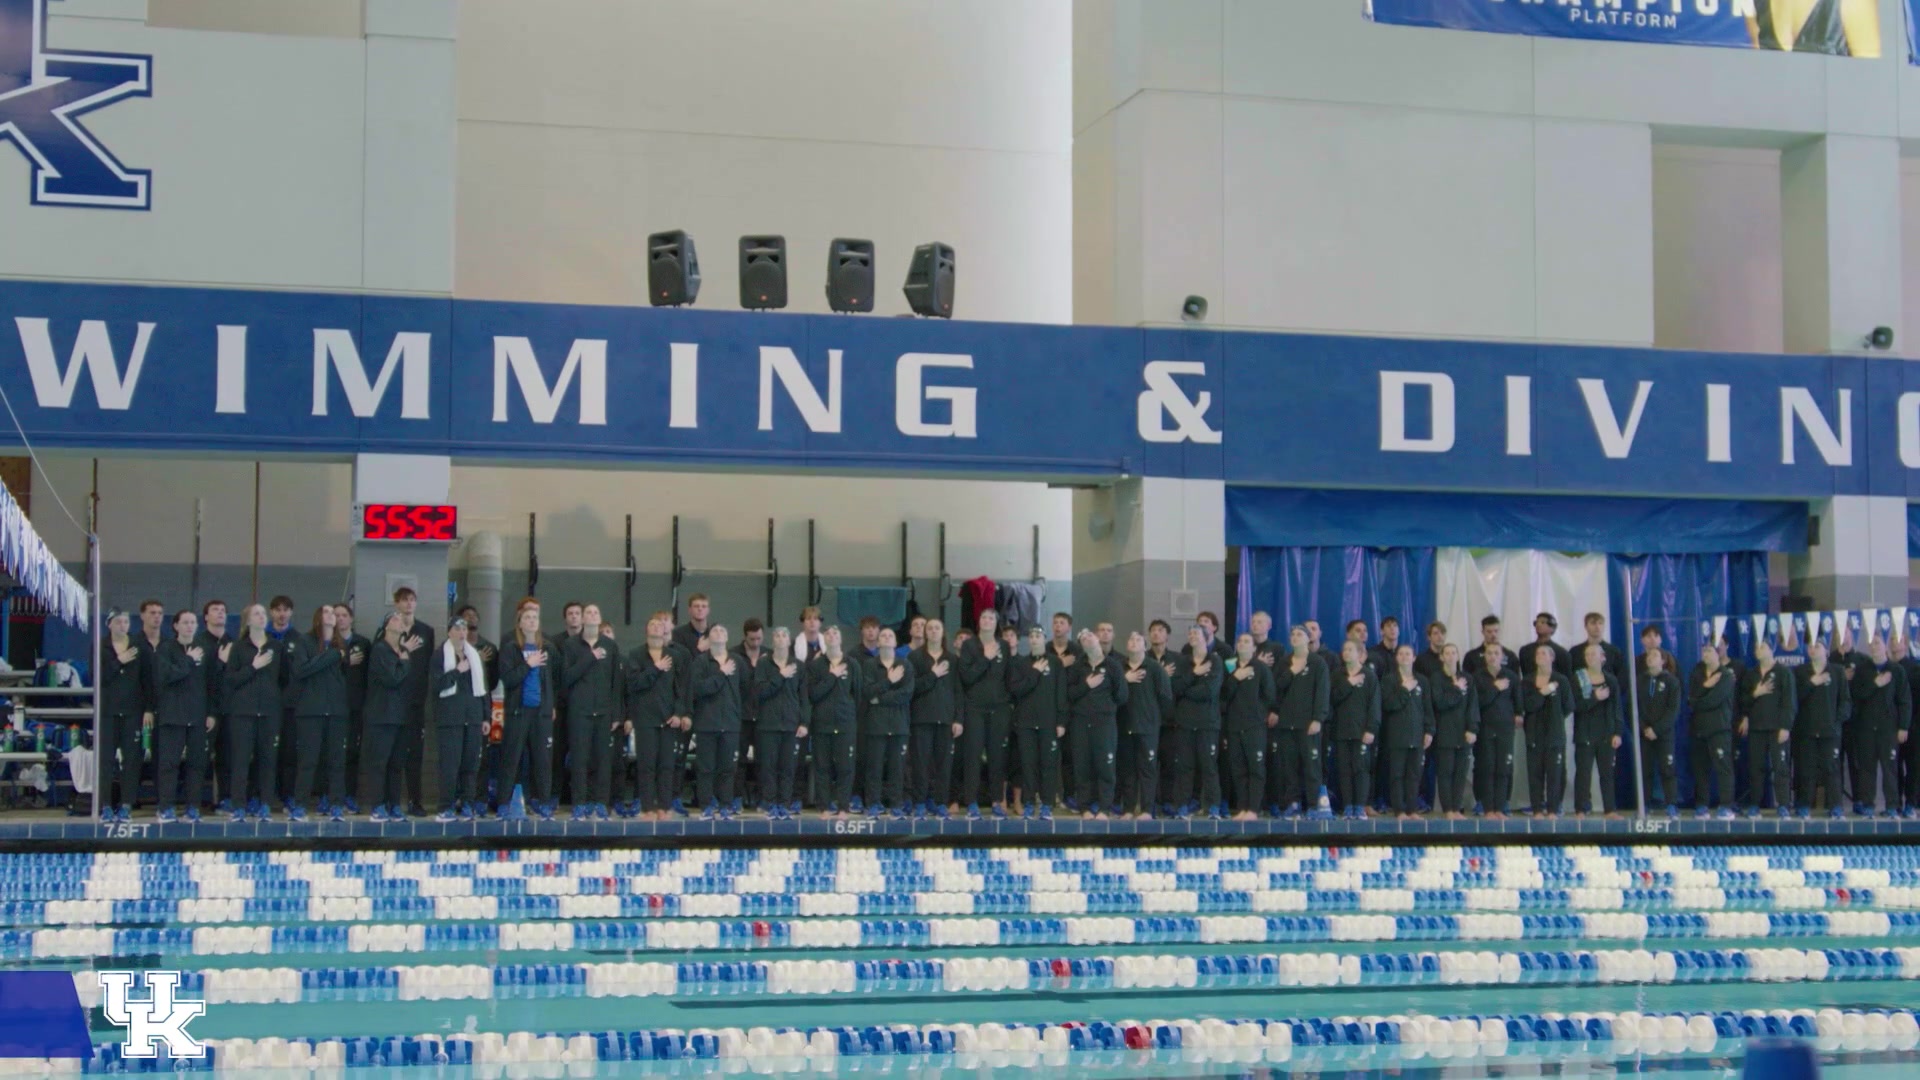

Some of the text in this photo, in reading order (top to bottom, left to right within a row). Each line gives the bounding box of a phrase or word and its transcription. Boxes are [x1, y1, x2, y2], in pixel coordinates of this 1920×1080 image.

[1570, 8, 1677, 28] PLATFORM
[1137, 360, 1223, 444] &
[1379, 370, 1920, 468] DIVIN
[103, 823, 151, 838] 7.5FT
[835, 820, 877, 834] 6.5FT
[1635, 820, 1672, 833] 6.5FT
